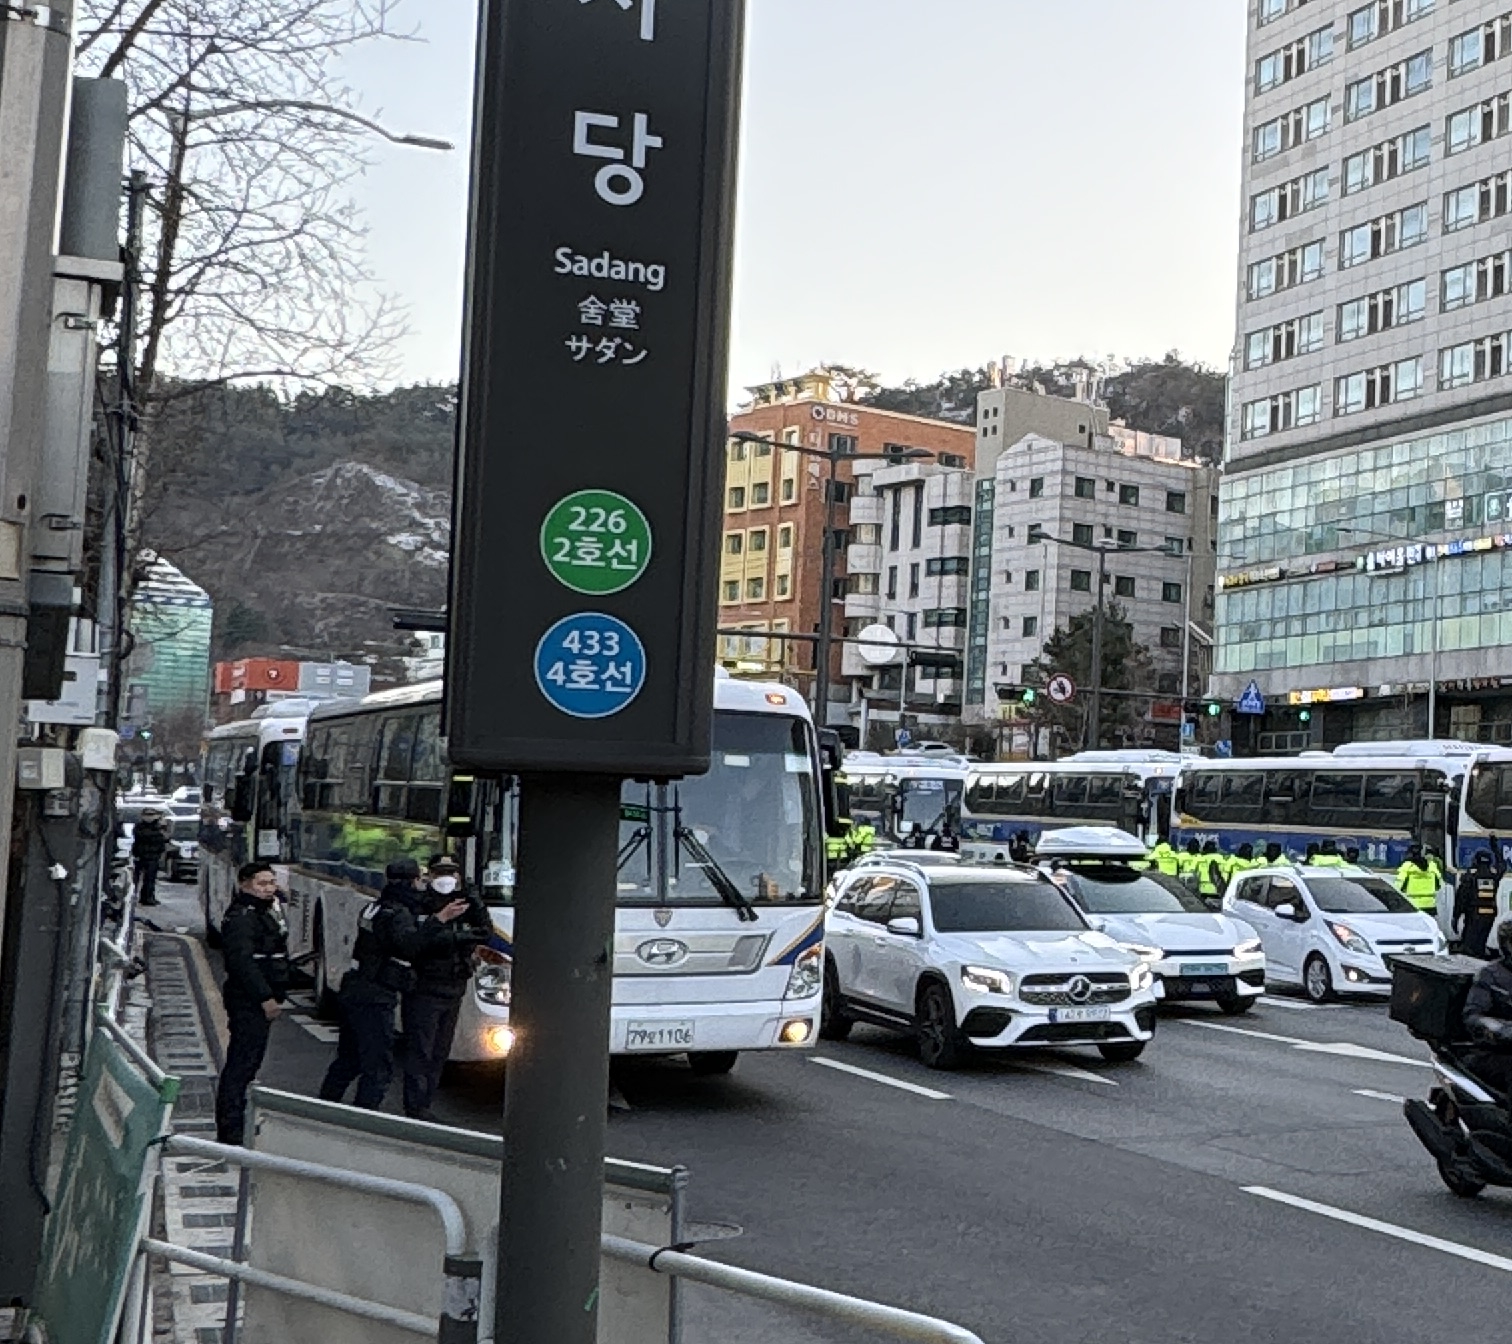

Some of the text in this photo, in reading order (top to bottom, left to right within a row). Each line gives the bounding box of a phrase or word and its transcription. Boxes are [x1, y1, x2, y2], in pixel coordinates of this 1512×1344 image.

[553, 246, 667, 292] Sadang
[577, 294, 643, 331] 舍堂
[564, 334, 648, 366] サダン
[567, 506, 627, 534] 226
[552, 536, 639, 571] 2호선
[561, 629, 621, 657] 433
[546, 658, 633, 694] 4호선
